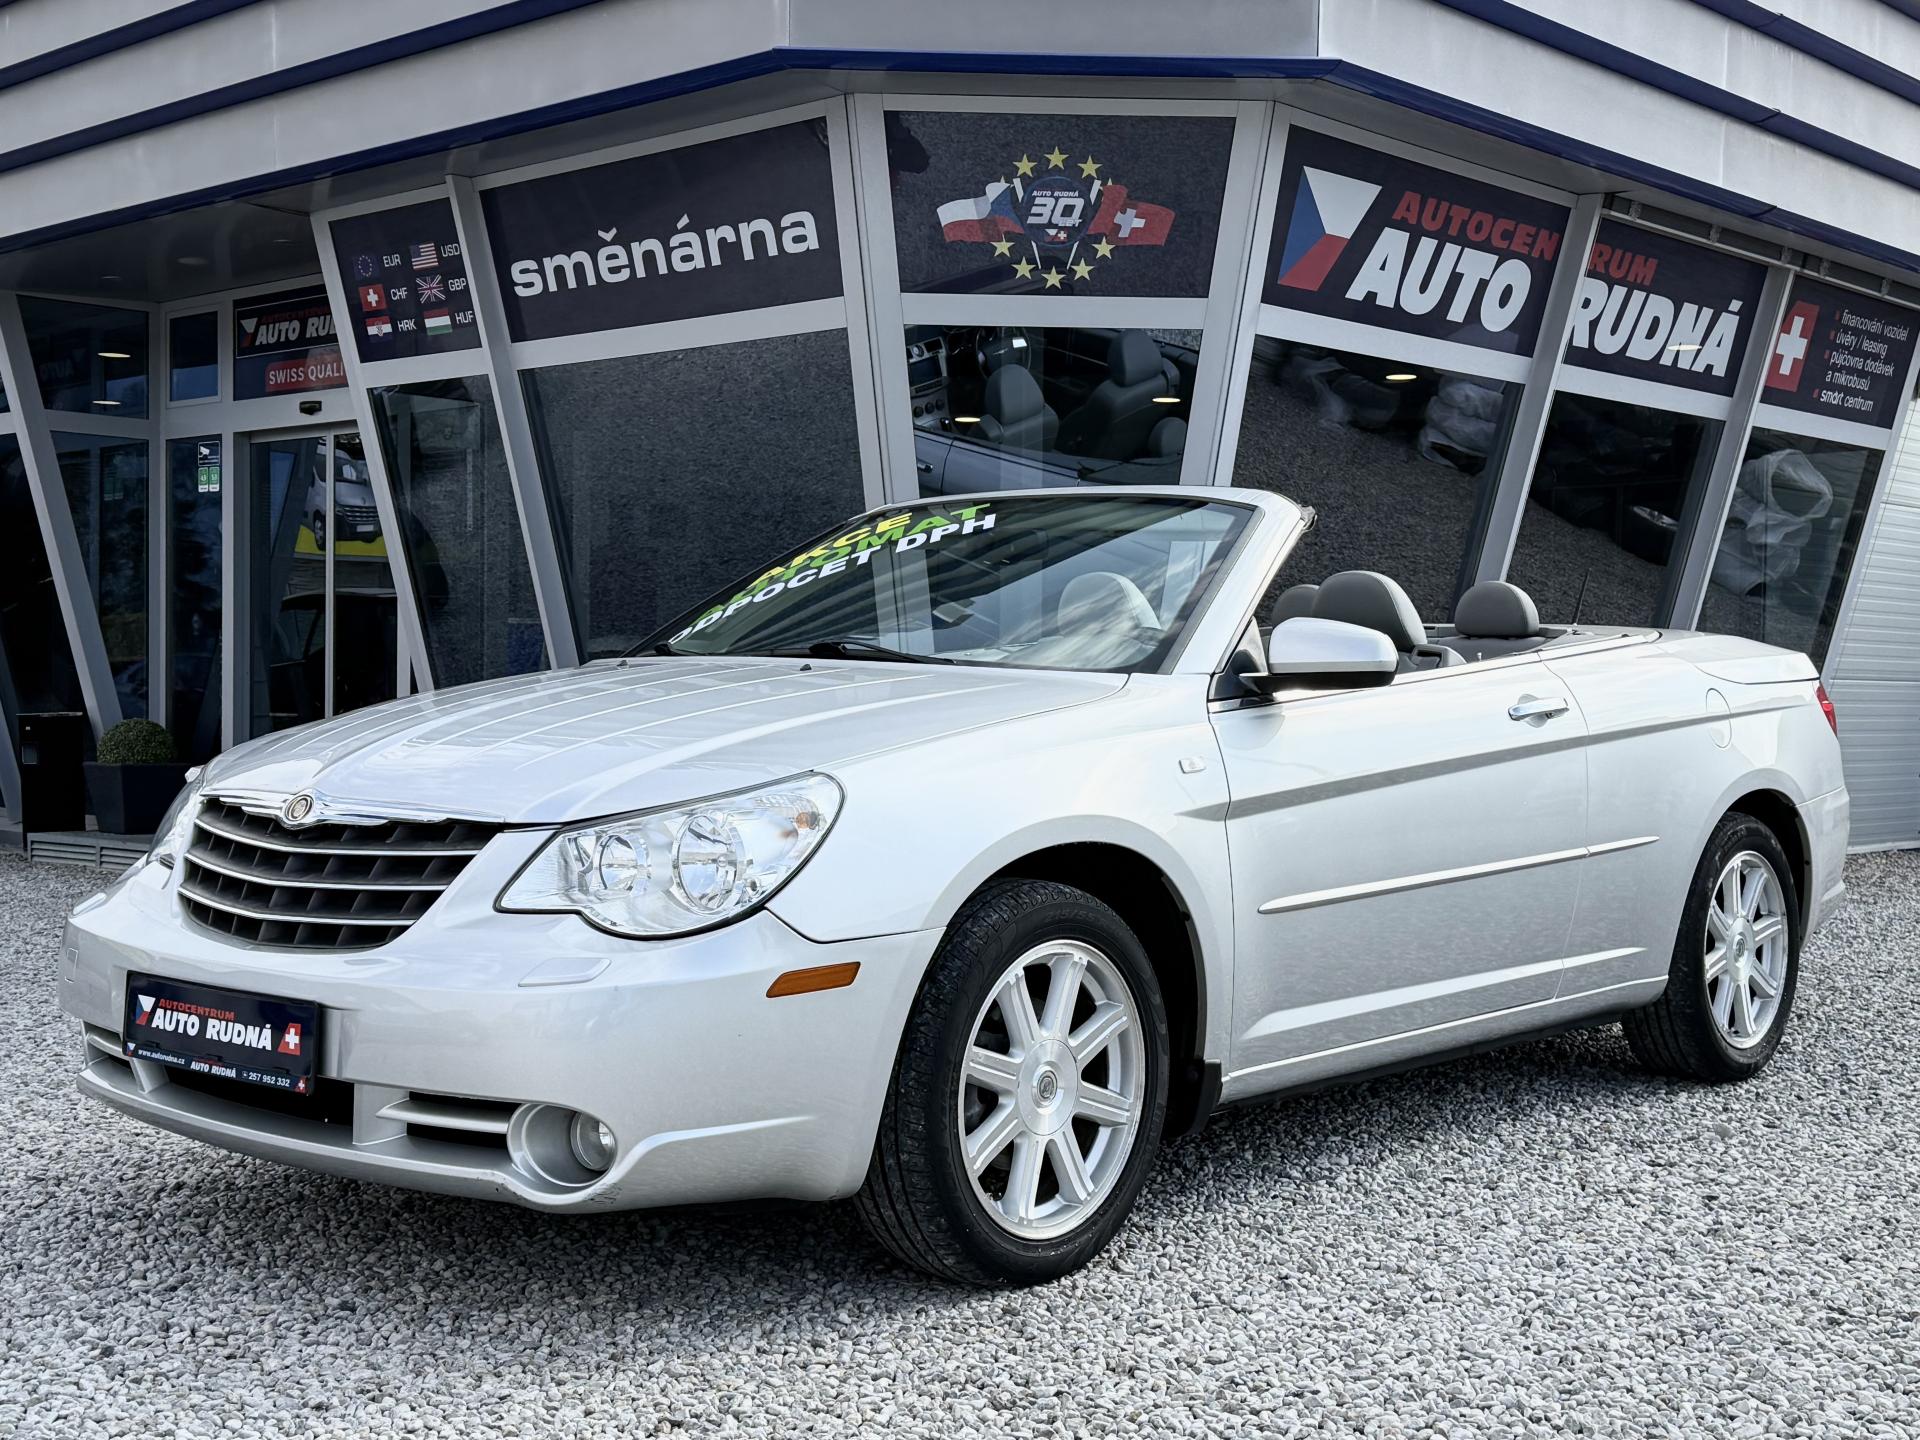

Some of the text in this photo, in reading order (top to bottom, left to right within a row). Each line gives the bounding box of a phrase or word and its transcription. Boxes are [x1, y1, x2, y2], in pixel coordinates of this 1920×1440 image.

[1027, 197, 1084, 224] 30
[440, 243, 460, 257] USD
[510, 212, 820, 297] směnárna
[382, 254, 402, 267] EUR
[390, 287, 408, 301] CHF
[448, 278, 467, 291] GBP
[1344, 226, 1744, 378] AUTO RUDNÁ
[397, 318, 417, 332] HRK
[454, 310, 474, 324] HUF
[1841, 309, 1910, 341] financování vozidel
[255, 320, 301, 346] AUTO
[1862, 335, 1888, 359] leasing
[269, 367, 305, 385] SWISS
[1825, 370, 1832, 382] a
[1865, 357, 1895, 377] dodávek
[1820, 389, 1874, 412] smart centrum
[745, 512, 913, 590] AKCE
[668, 513, 997, 645] ODPOCET DPH
[158, 998, 235, 1021] AUTOCENTRUM
[151, 1008, 272, 1051] AUTO RUDNÁ
[137, 1049, 186, 1065] www.autorudna.cz
[190, 1060, 209, 1073] AUTO
[210, 1065, 236, 1078] RUDNÁ
[248, 1071, 290, 1087] 257 952 332
